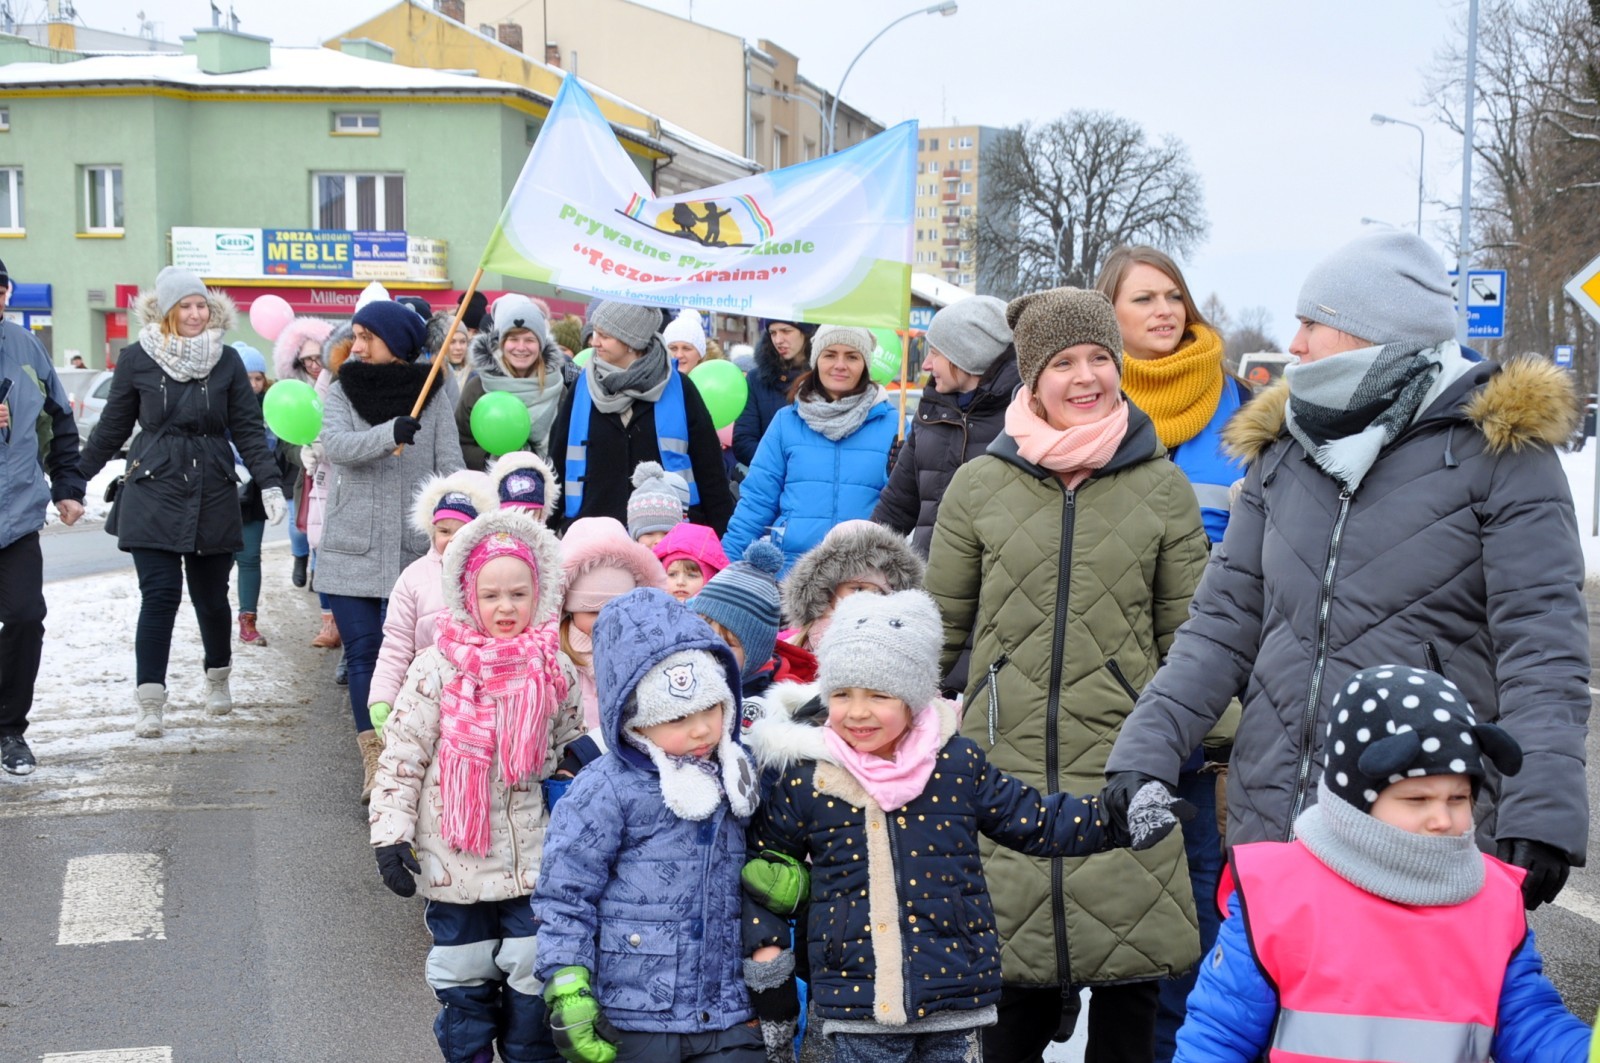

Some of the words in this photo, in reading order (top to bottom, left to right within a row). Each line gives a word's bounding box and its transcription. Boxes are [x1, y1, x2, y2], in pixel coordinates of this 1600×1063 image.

[275, 231, 314, 242] ZORZA
[559, 203, 671, 262] Prywatne
[267, 242, 349, 262] MEBLE
[1467, 325, 1499, 334] nieżka
